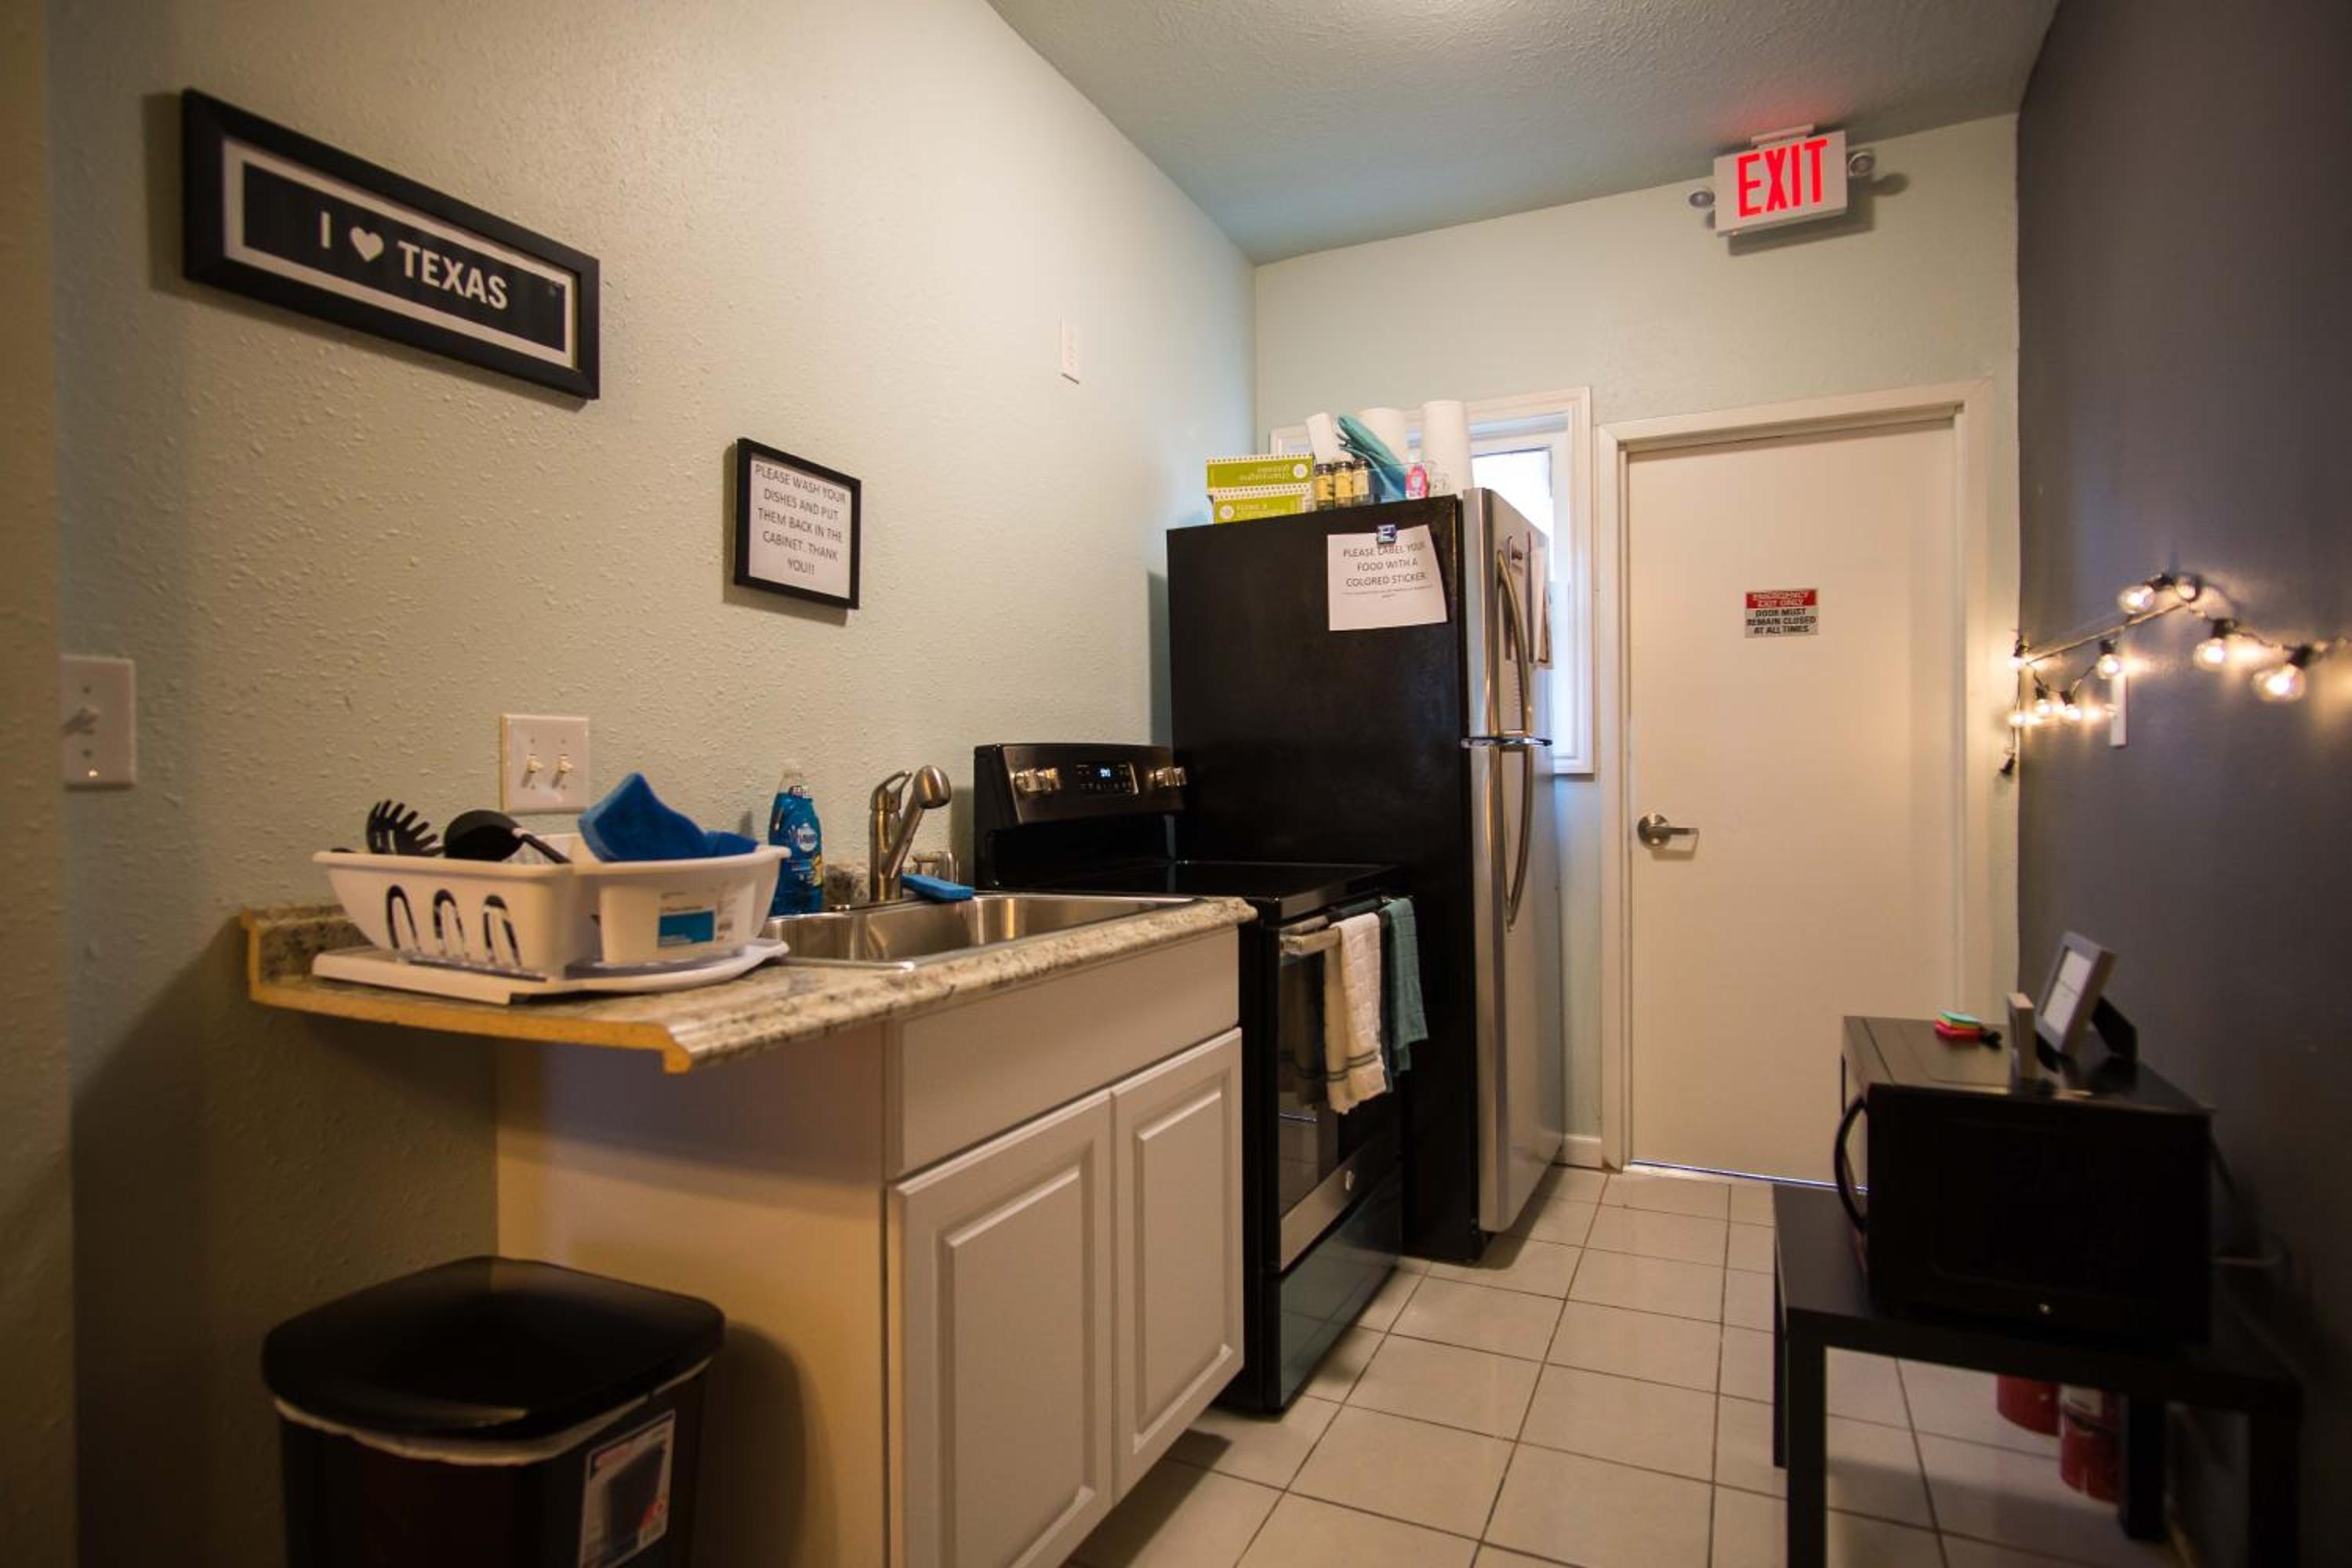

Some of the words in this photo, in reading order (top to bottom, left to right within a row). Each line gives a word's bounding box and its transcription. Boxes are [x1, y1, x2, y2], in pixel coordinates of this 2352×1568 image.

[1737, 138, 1828, 218] EXIT
[320, 211, 331, 249] I
[397, 240, 508, 310] TEXAS
[755, 464, 791, 485] PLEASE
[793, 477, 820, 493] WASH
[821, 486, 846, 503] YOUR
[764, 488, 797, 508] DISHES
[799, 499, 819, 514] AND
[822, 506, 839, 520] PUT
[757, 508, 786, 525] THEM
[789, 517, 813, 533] BACK
[815, 525, 824, 537] IN
[827, 528, 841, 543] THE
[808, 542, 837, 562] THANK
[1343, 549, 1376, 557] PLEASE
[1378, 544, 1405, 556] LABEL
[1357, 561, 1383, 572] FOOD
[1385, 559, 1410, 570] WITH
[1412, 557, 1418, 566] A
[1346, 576, 1390, 587] COLORED
[1746, 618, 1780, 626] REMAIN
[1783, 615, 1817, 625] CLOSED
[1781, 608, 1806, 616] MUST
